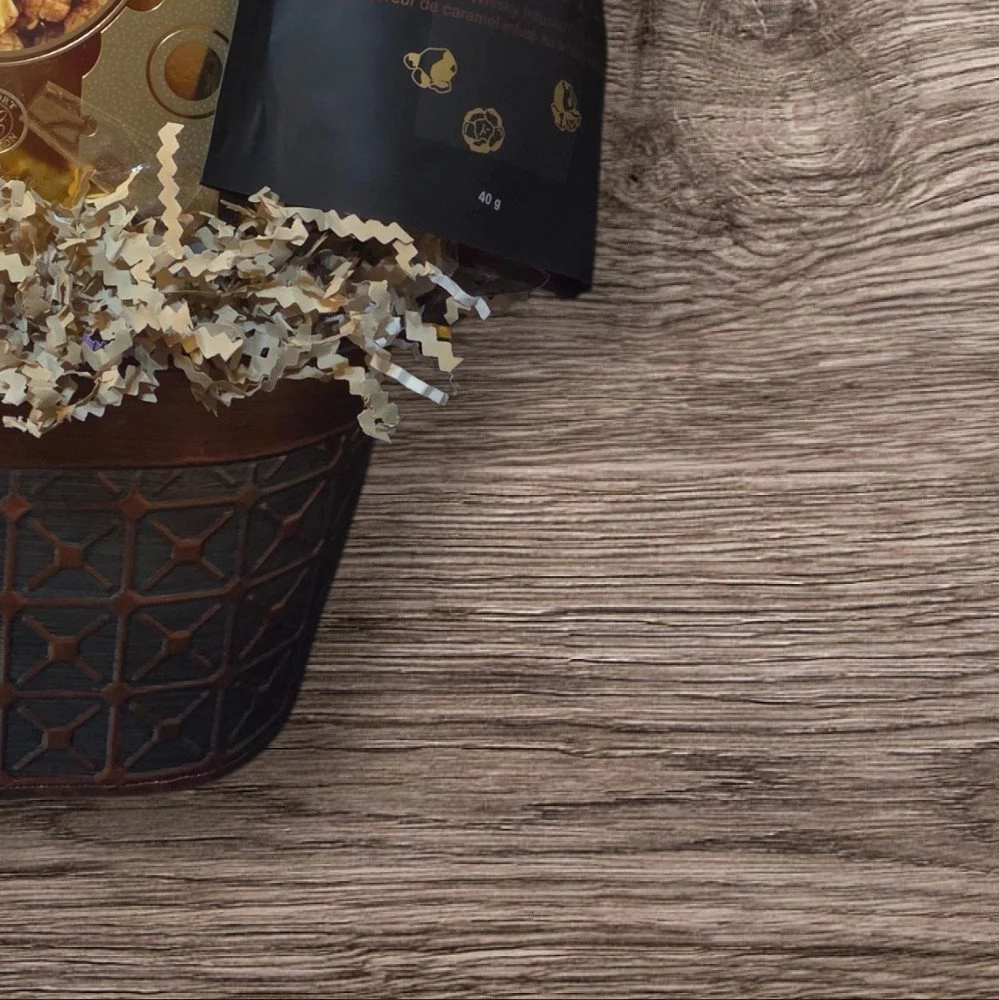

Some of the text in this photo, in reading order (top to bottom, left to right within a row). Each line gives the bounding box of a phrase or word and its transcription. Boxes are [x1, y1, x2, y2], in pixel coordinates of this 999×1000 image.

[442, 4, 502, 31] caramel
[478, 190, 502, 211] 40 g
